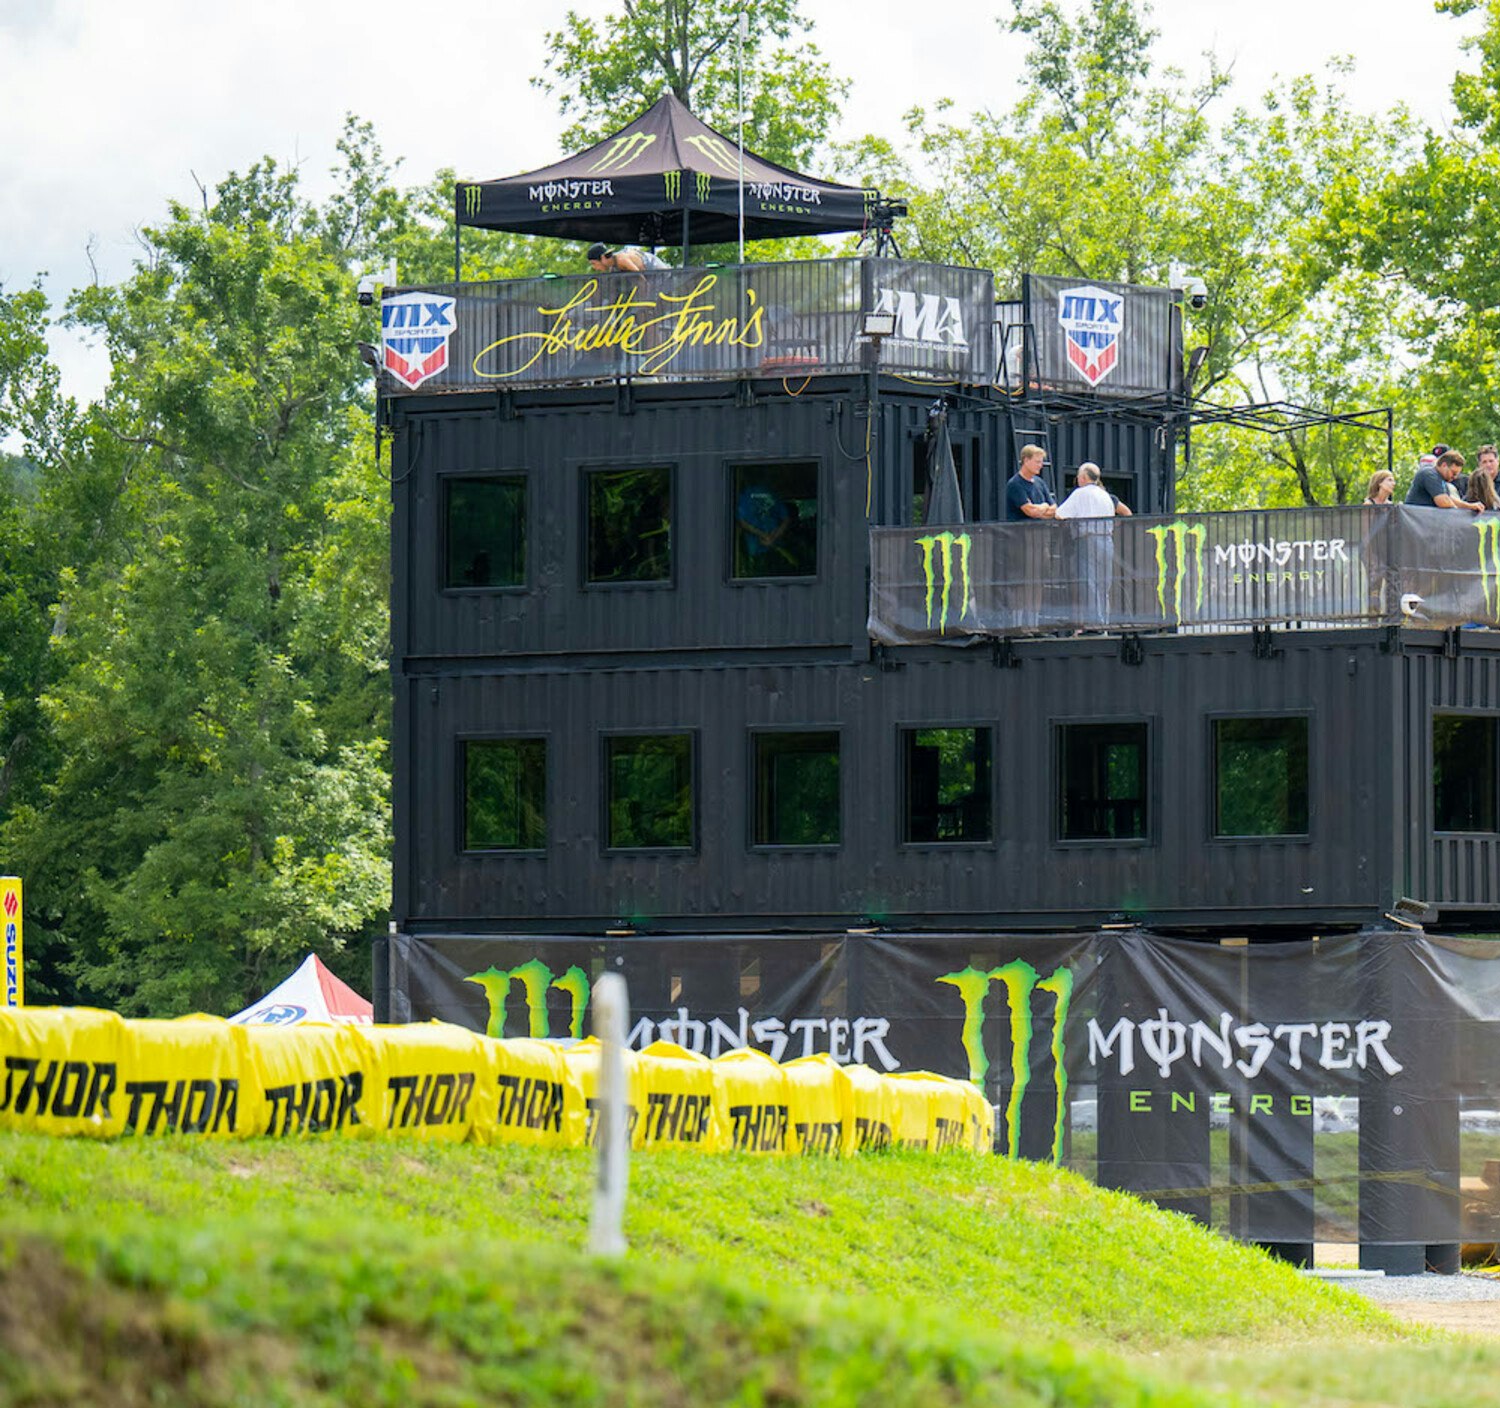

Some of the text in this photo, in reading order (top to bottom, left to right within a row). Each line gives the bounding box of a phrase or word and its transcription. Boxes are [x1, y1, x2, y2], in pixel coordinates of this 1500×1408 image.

[528, 179, 614, 203] MONSTER
[749, 182, 821, 205] MONSTER
[541, 200, 603, 213] ENERGY
[760, 202, 812, 215] ENERGY
[382, 302, 453, 328] MX
[1062, 295, 1121, 323] MX
[473, 274, 765, 377] Loretta Lynn's
[1214, 537, 1348, 569] MONSTER
[1233, 570, 1325, 583] ENERGY
[1087, 1007, 1403, 1078] MONSTER
[0, 1056, 117, 1119] THOR
[388, 1072, 475, 1129] THOR
[124, 1078, 239, 1137] THOR
[265, 1071, 364, 1136] THOR
[498, 1074, 564, 1133] THOR
[1130, 1091, 1348, 1117] ENERGY
